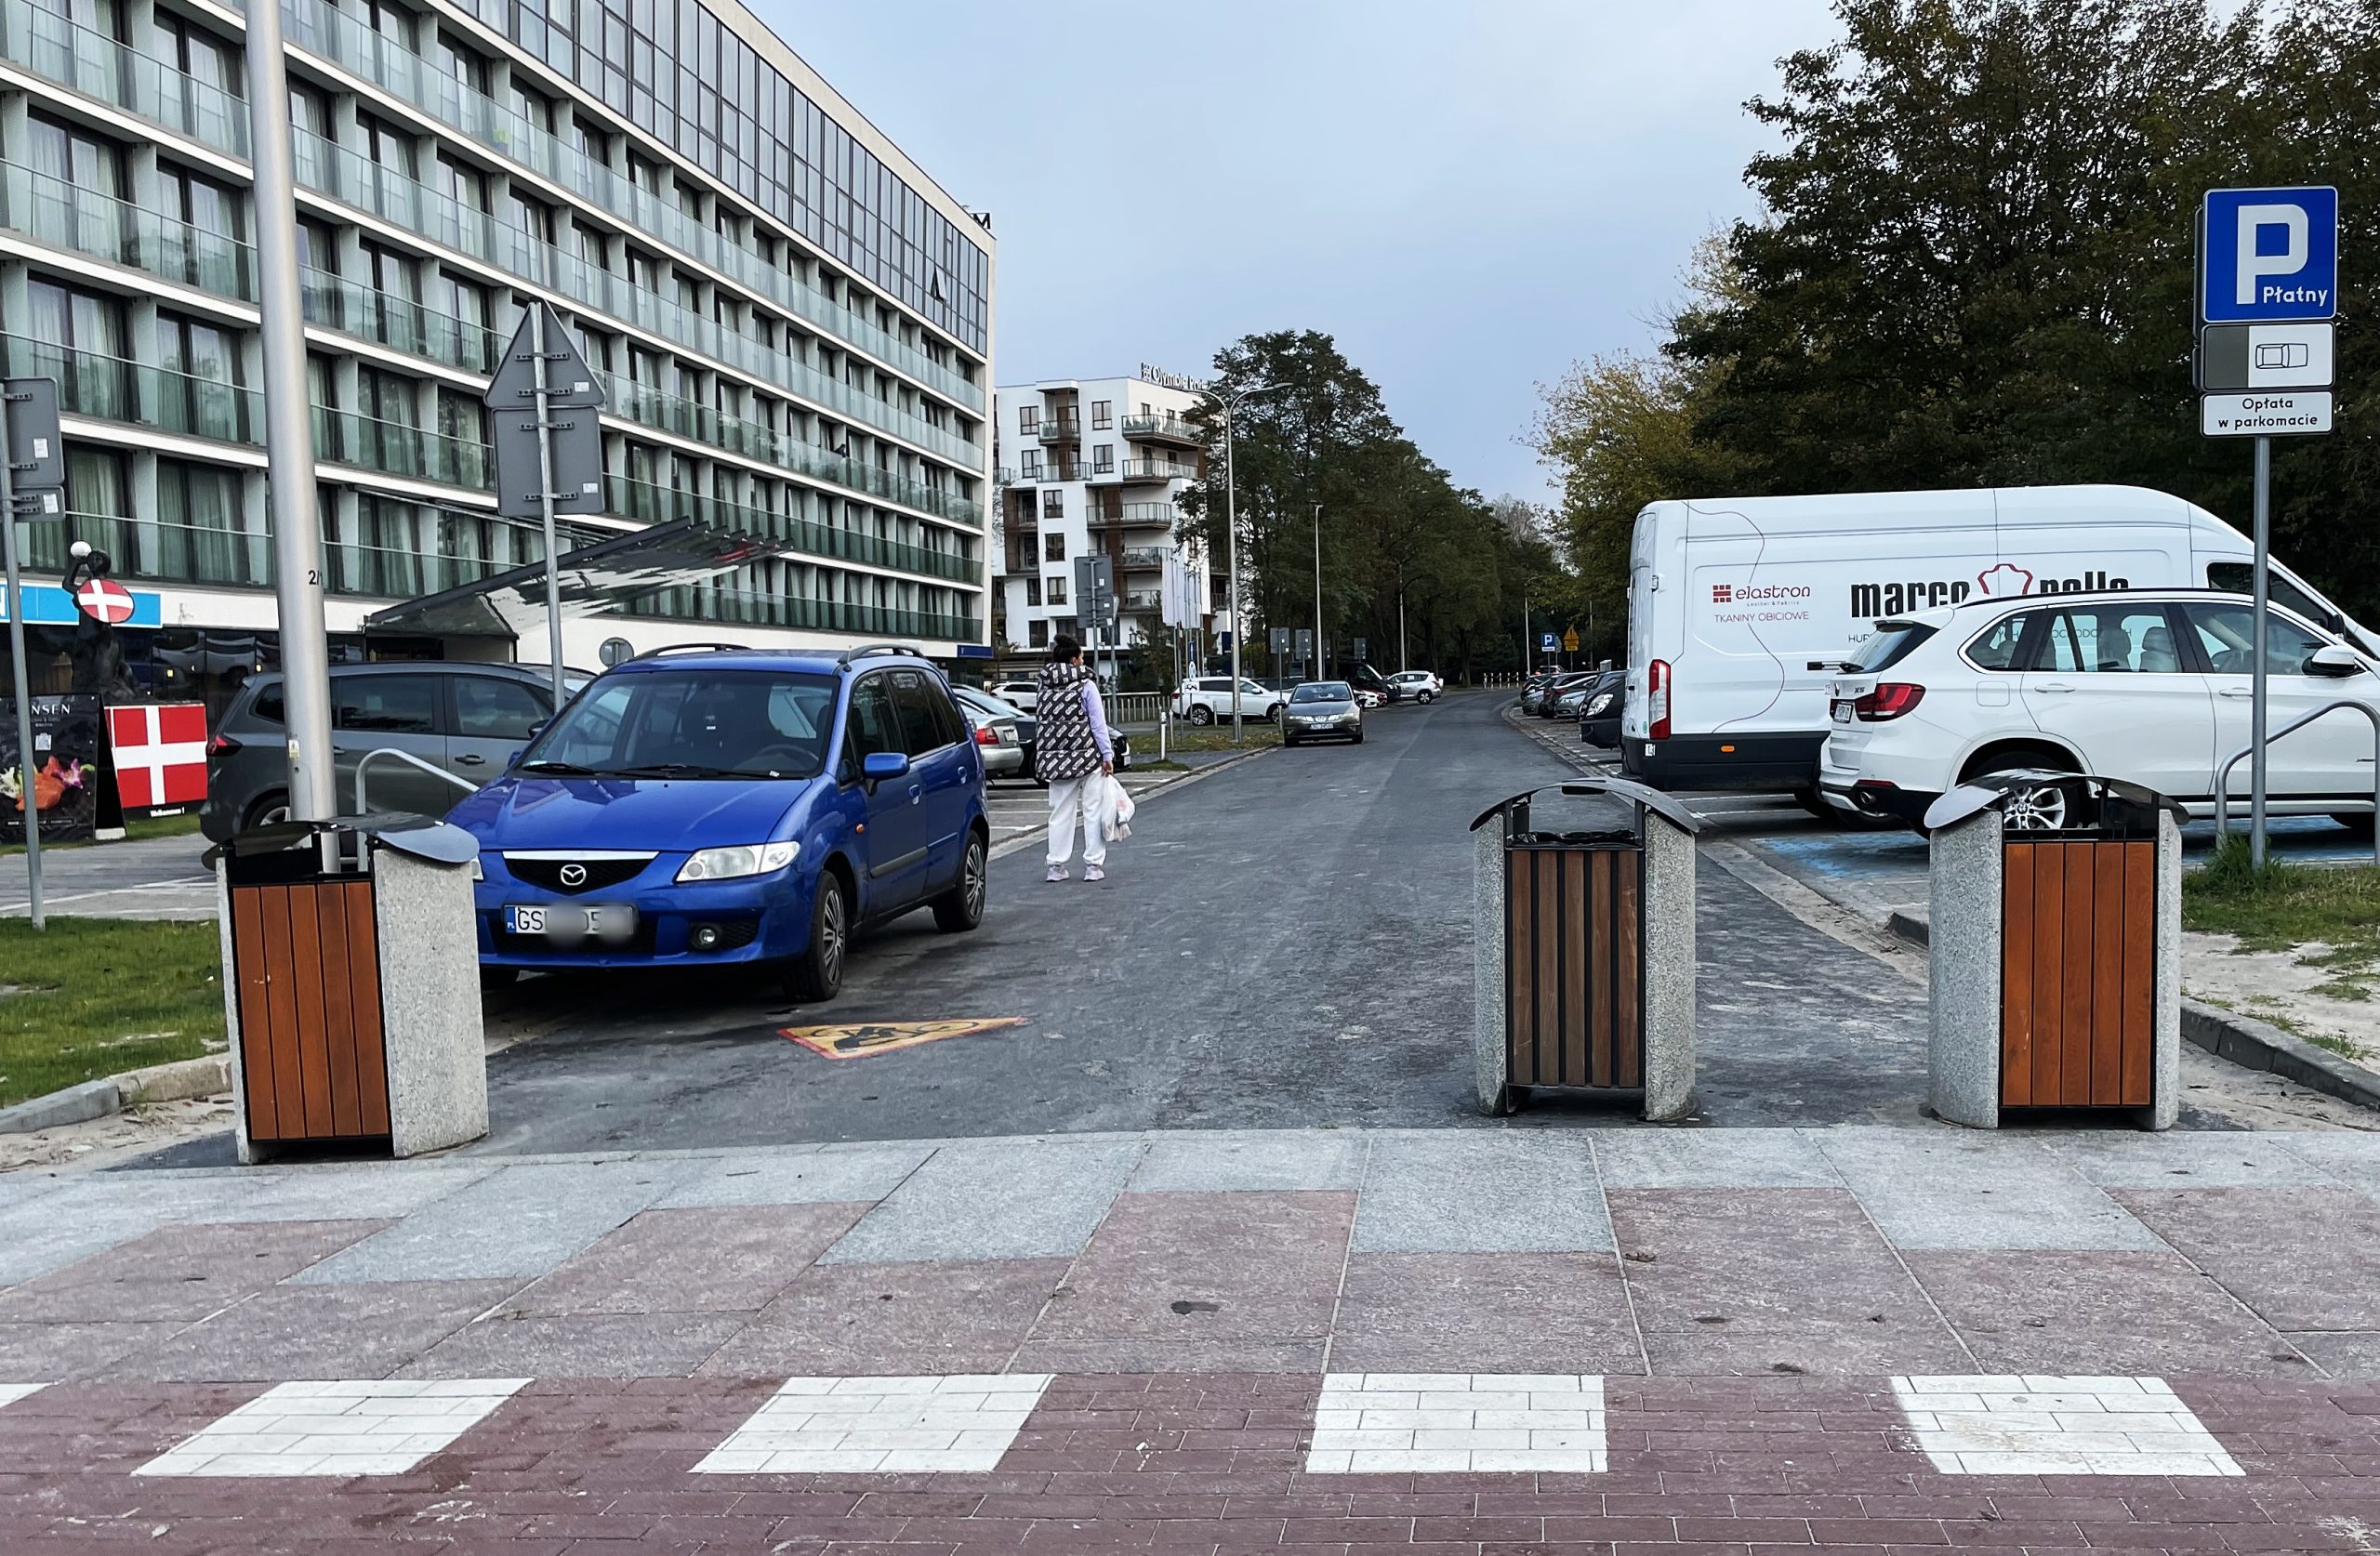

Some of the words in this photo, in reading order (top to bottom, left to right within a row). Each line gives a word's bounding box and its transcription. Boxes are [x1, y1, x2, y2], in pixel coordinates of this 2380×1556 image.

[2236, 204, 2309, 305] P
[2263, 285, 2328, 307] Płatny
[2241, 397, 2294, 413] Opłata
[2218, 419, 2228, 428] w
[2234, 413, 2318, 430] parkomacie
[1735, 585, 1811, 600] elastron
[1851, 581, 1970, 618] marco
[1714, 613, 1756, 624] TKANINY
[1758, 611, 1810, 622] OBICIOWE
[1544, 634, 1553, 646] P
